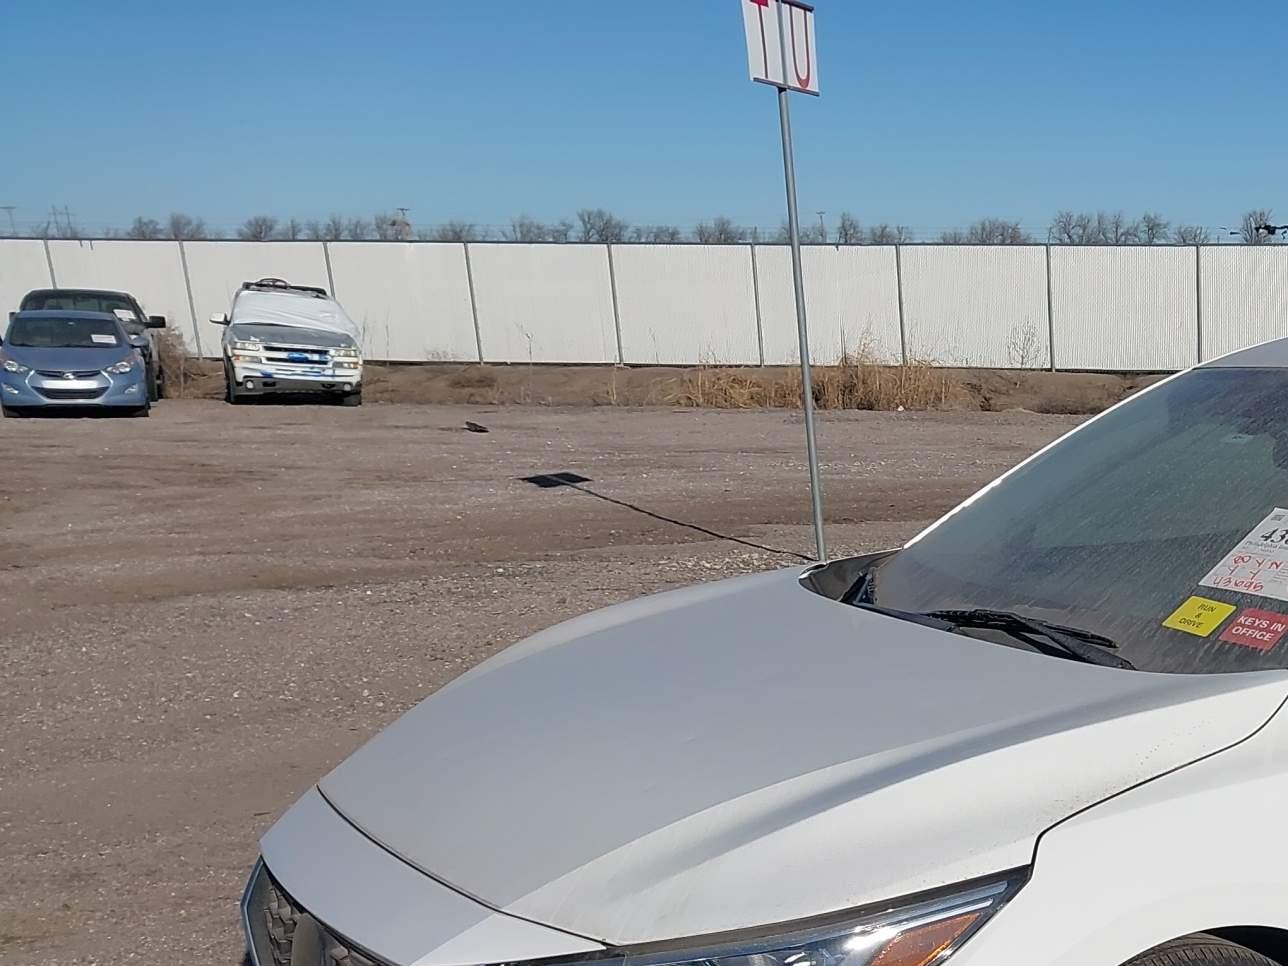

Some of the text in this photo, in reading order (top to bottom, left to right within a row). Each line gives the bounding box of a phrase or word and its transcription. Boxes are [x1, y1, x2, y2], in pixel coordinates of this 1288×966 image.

[1197, 603, 1217, 613] RUN
[1178, 617, 1205, 630] DRIVE
[1237, 615, 1287, 633] KEYS IN
[1231, 625, 1275, 642] OFFICE
